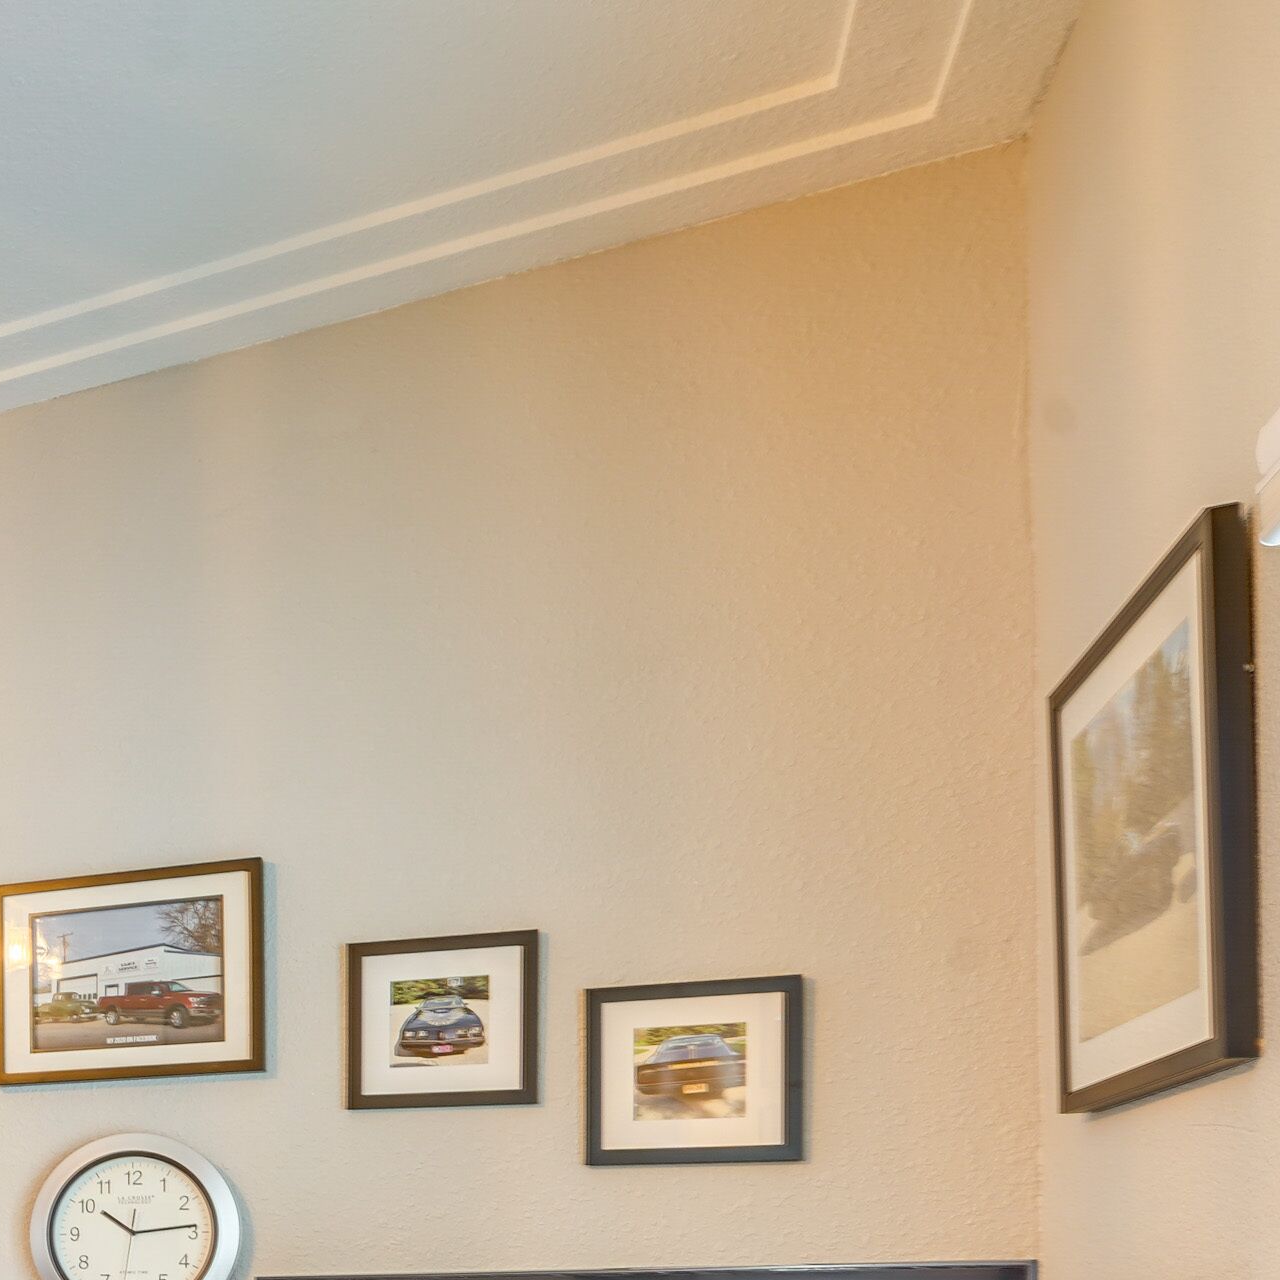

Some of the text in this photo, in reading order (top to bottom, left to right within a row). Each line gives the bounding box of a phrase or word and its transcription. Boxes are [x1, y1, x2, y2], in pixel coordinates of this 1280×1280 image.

[124, 1170, 143, 1186] 12
[160, 1177, 166, 1193] 1
[97, 1179, 111, 1195] 11
[78, 1198, 96, 1214] 10
[179, 1195, 190, 1211] 2
[69, 1226, 80, 1242] 9
[187, 1225, 198, 1240] 3
[78, 1254, 89, 1270] 8
[178, 1253, 190, 1269] 4
